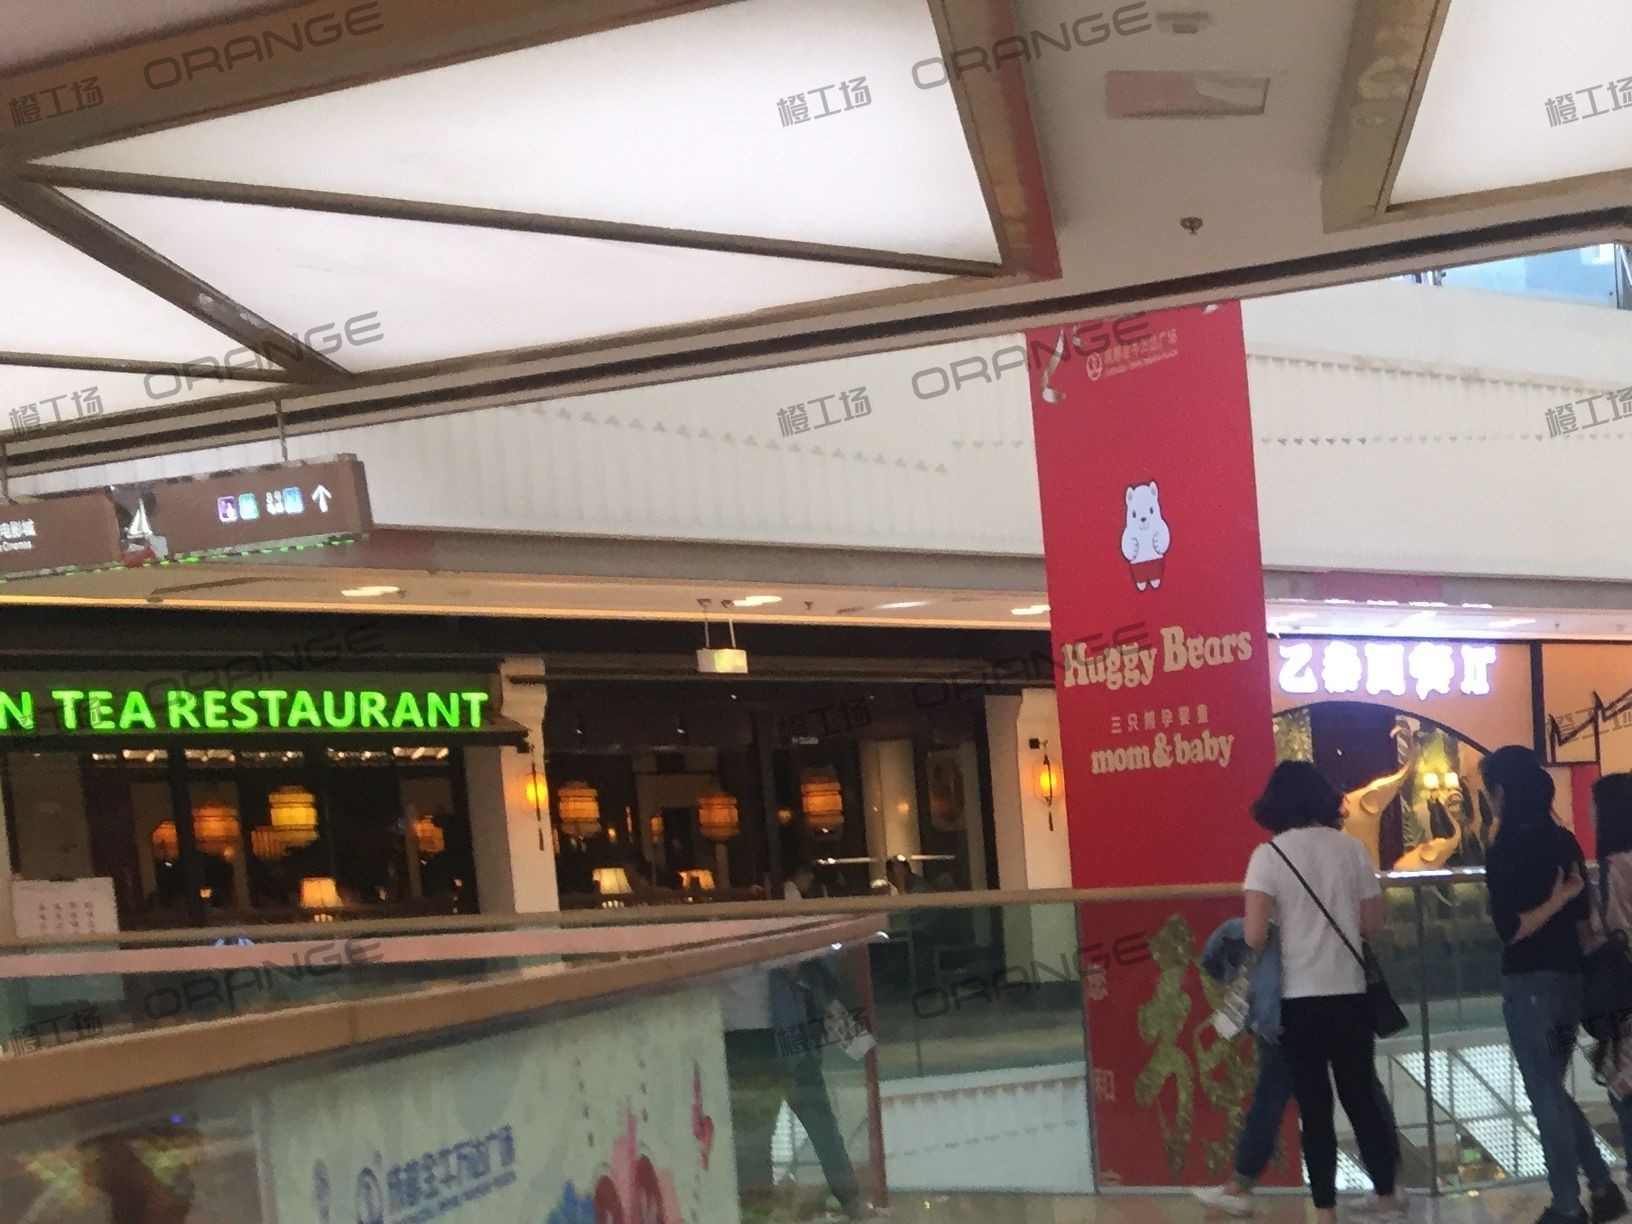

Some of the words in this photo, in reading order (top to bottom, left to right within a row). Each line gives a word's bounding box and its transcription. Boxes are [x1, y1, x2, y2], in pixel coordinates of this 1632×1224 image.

[1062, 642, 1158, 690] Huggy
[1160, 625, 1253, 672] Bears
[51, 690, 156, 729] TEA
[167, 690, 488, 729] RESTAURANT
